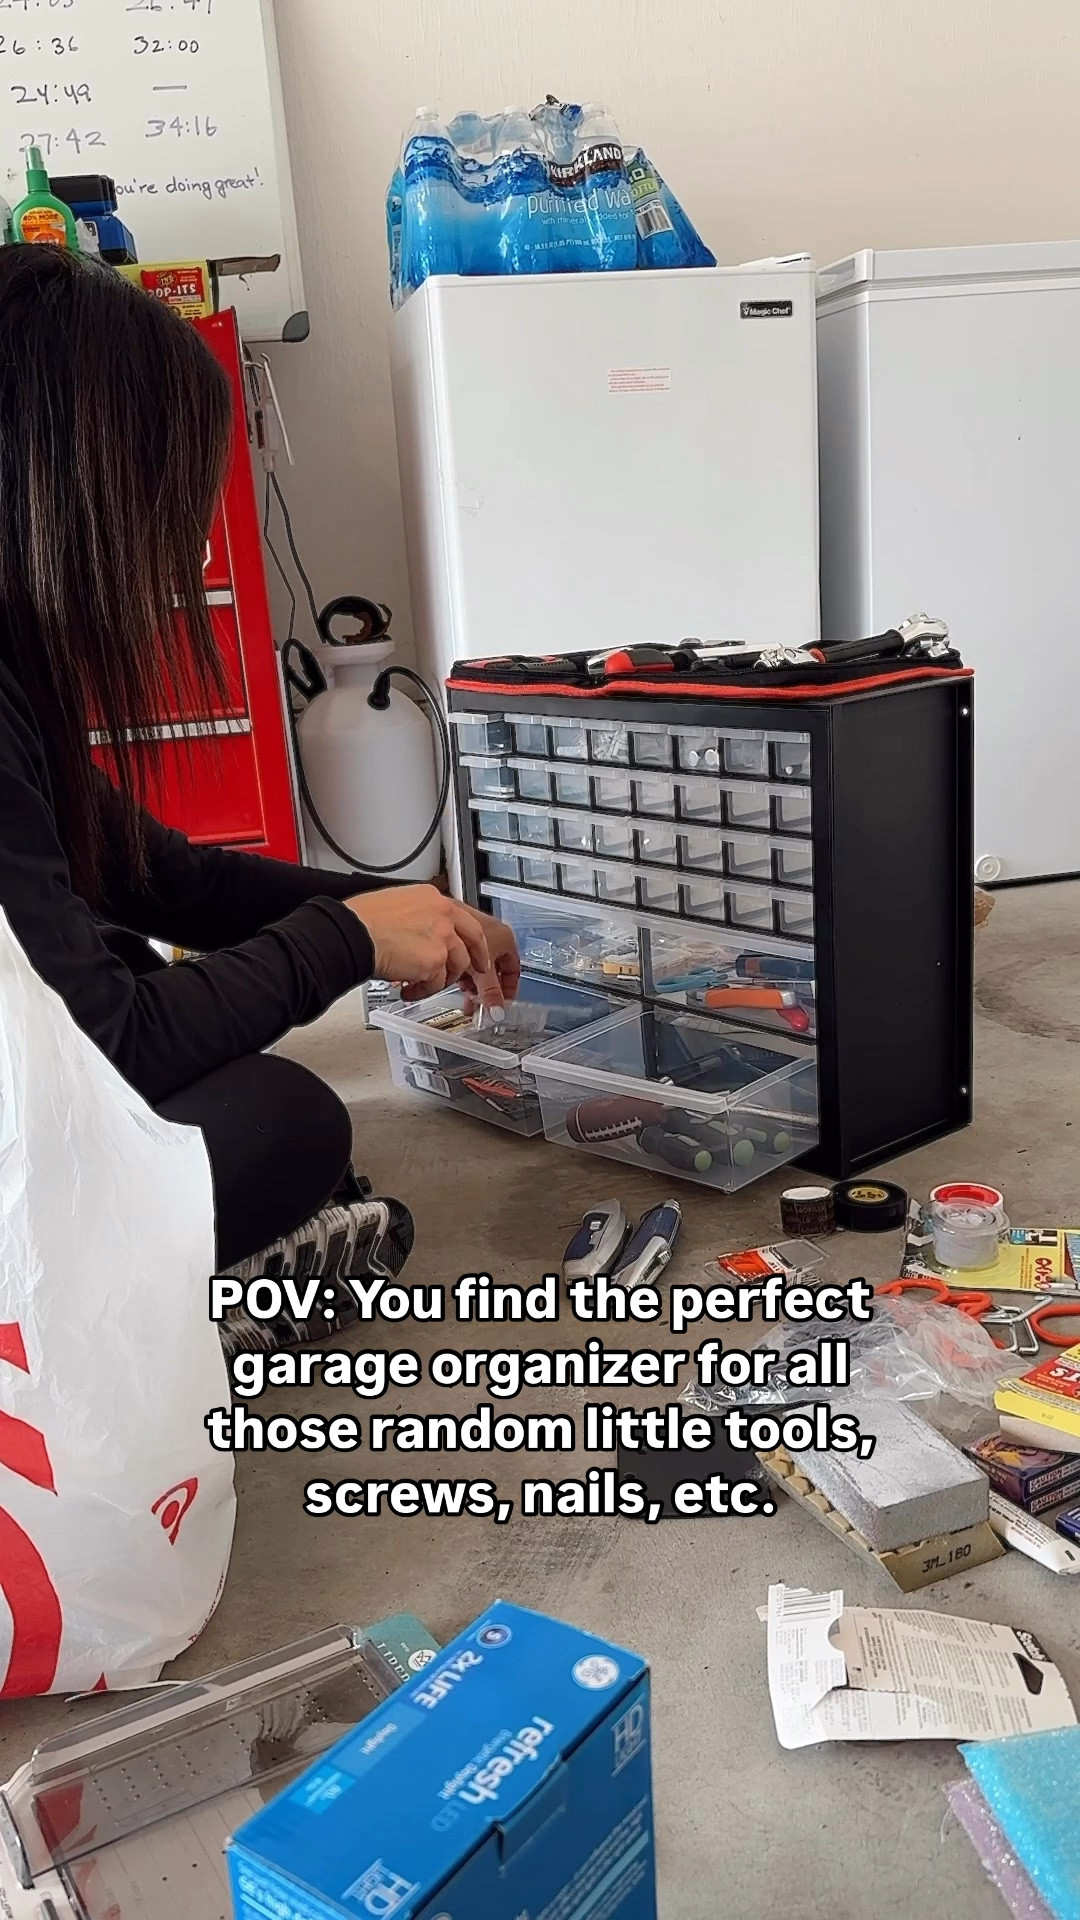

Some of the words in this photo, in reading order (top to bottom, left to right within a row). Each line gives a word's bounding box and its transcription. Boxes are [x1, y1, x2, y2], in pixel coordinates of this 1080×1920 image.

[133, 35, 200, 55] 32:00
[10, 83, 92, 105] 24:49
[145, 116, 218, 138] 34:16
[551, 146, 622, 179] KIRKLAND
[115, 178, 158, 195] ou're
[166, 176, 212, 200] doing
[215, 167, 264, 198] great!
[413, 1669, 464, 1710] LIFE
[457, 1716, 555, 1805] refresh
[431, 1800, 466, 1832] LED
